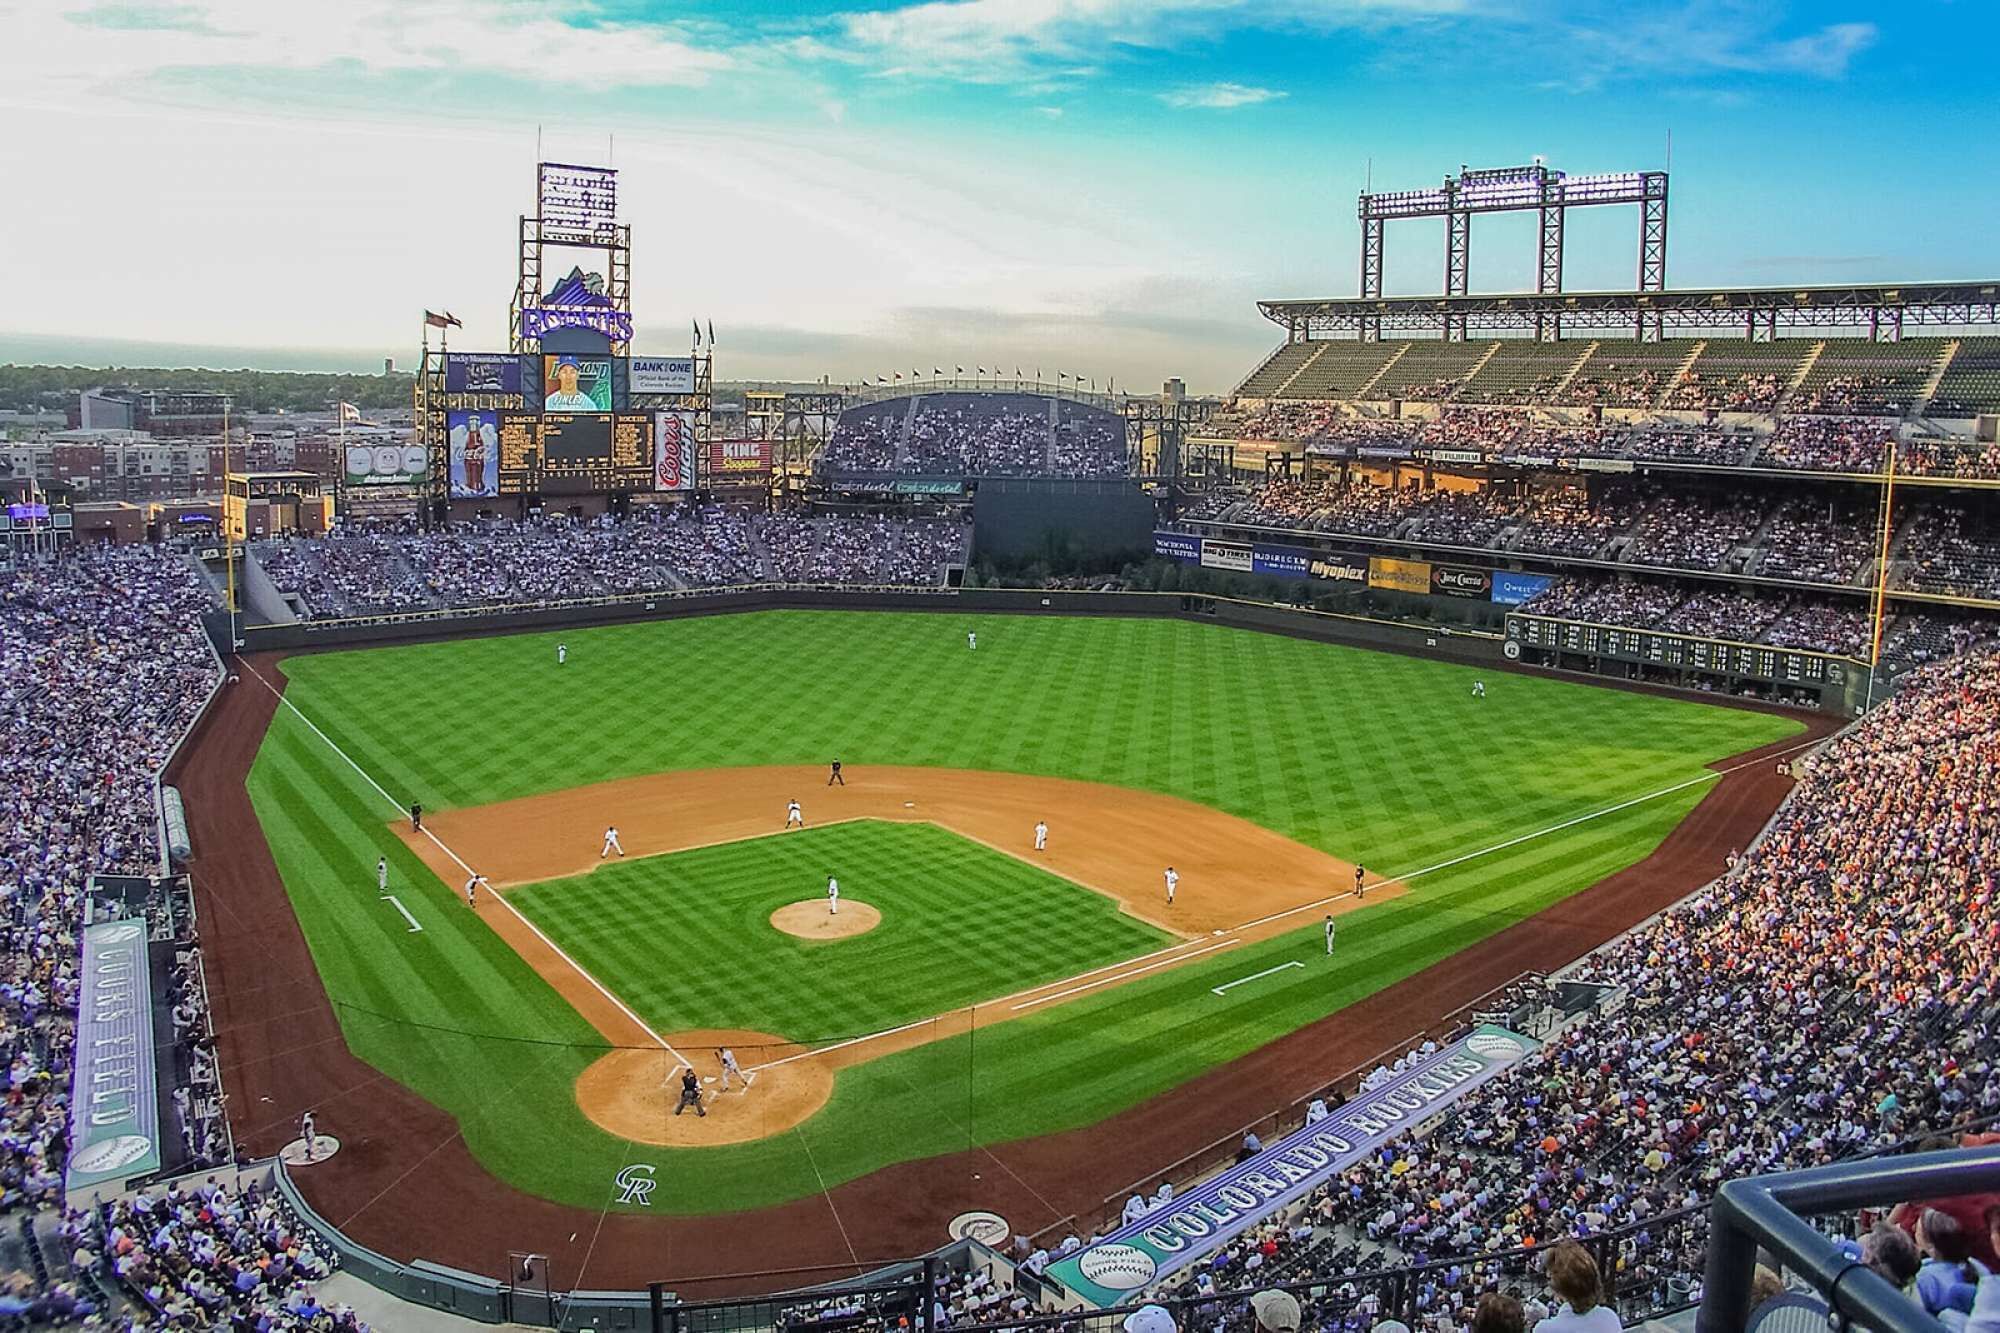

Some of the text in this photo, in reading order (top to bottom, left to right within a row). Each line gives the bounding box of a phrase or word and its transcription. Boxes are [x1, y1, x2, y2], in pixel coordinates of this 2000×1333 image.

[633, 362, 692, 373] BANK ONE
[659, 414, 681, 487] Coors
[723, 443, 761, 457] KING
[1203, 548, 1217, 556] BIG
[1226, 549, 1251, 558] TIRES
[1310, 560, 1366, 581] Myoplex
[1457, 573, 1482, 586] Cuervo
[1503, 582, 1531, 594] Qwest
[1143, 1054, 1485, 1253] COLORADO ROCKIES
